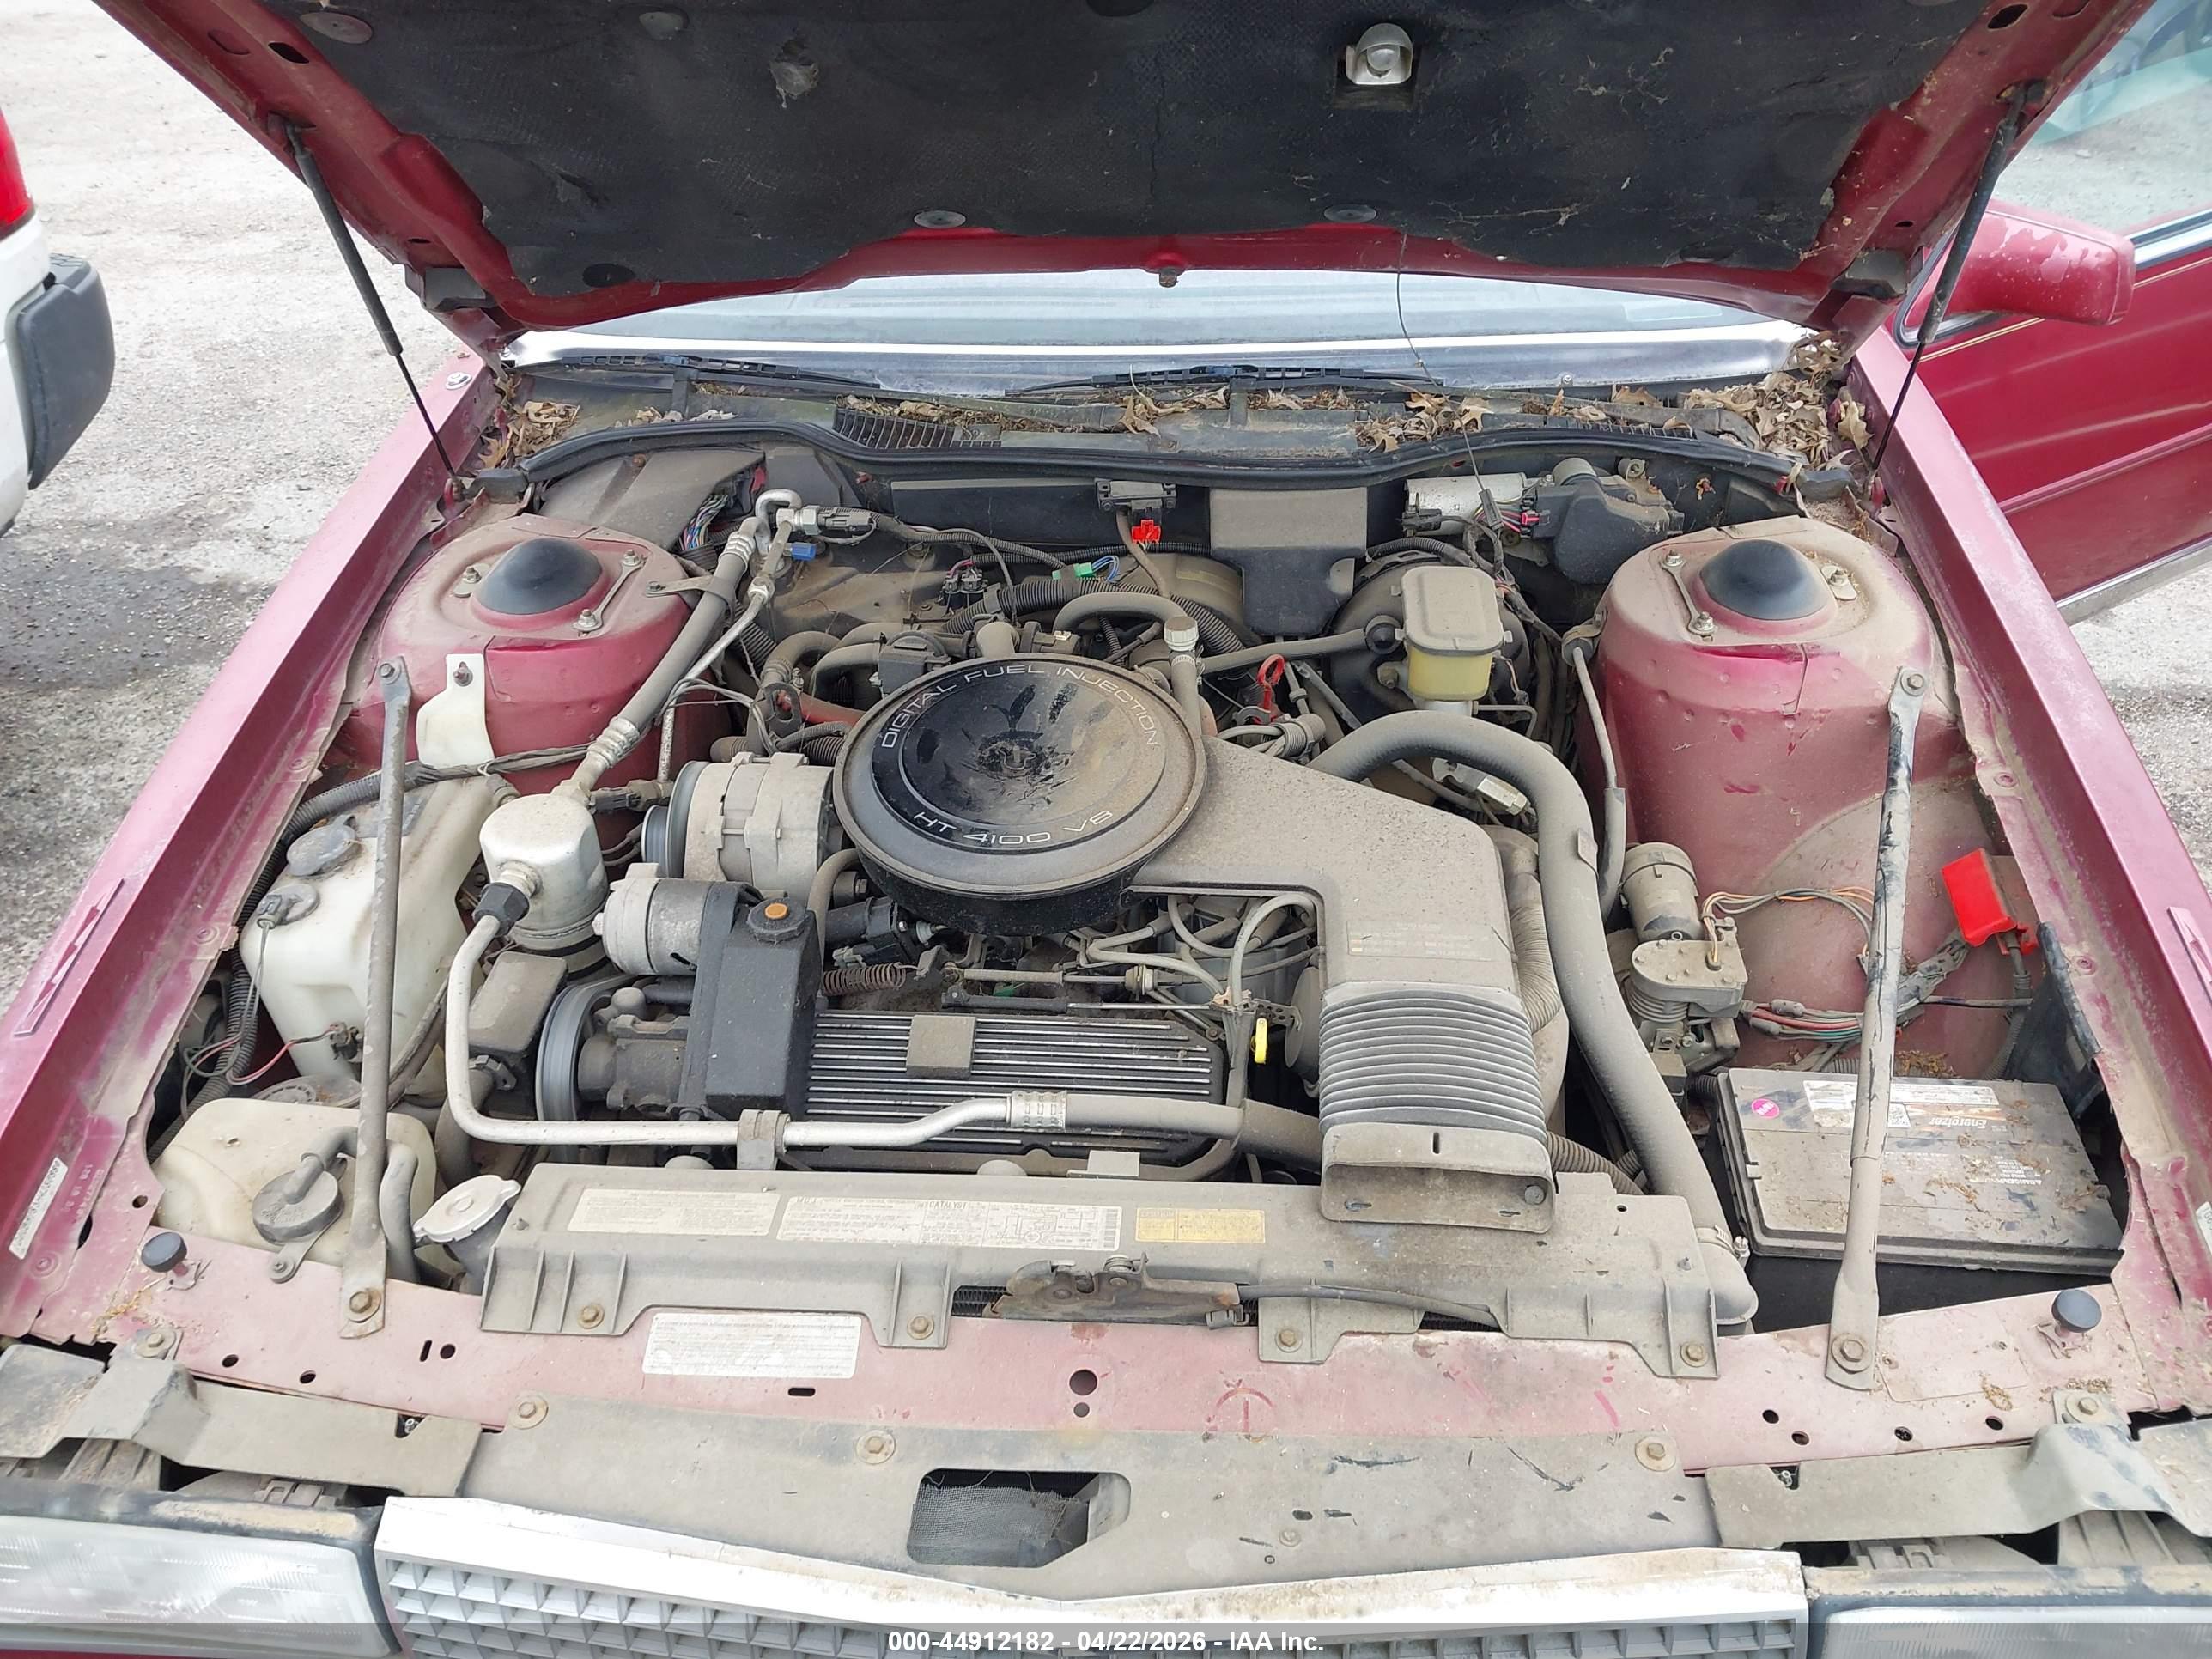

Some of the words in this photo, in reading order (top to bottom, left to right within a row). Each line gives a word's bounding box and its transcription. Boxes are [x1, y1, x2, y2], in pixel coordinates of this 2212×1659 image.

[882, 684, 957, 748] DIGITAL
[964, 665, 1045, 684] FUEL
[1056, 666, 1159, 746] INJECTION
[914, 811, 957, 832] HT
[963, 831, 1051, 844] 4100
[1063, 810, 1114, 832] V8
[1929, 1117, 1988, 1129] Energizer
